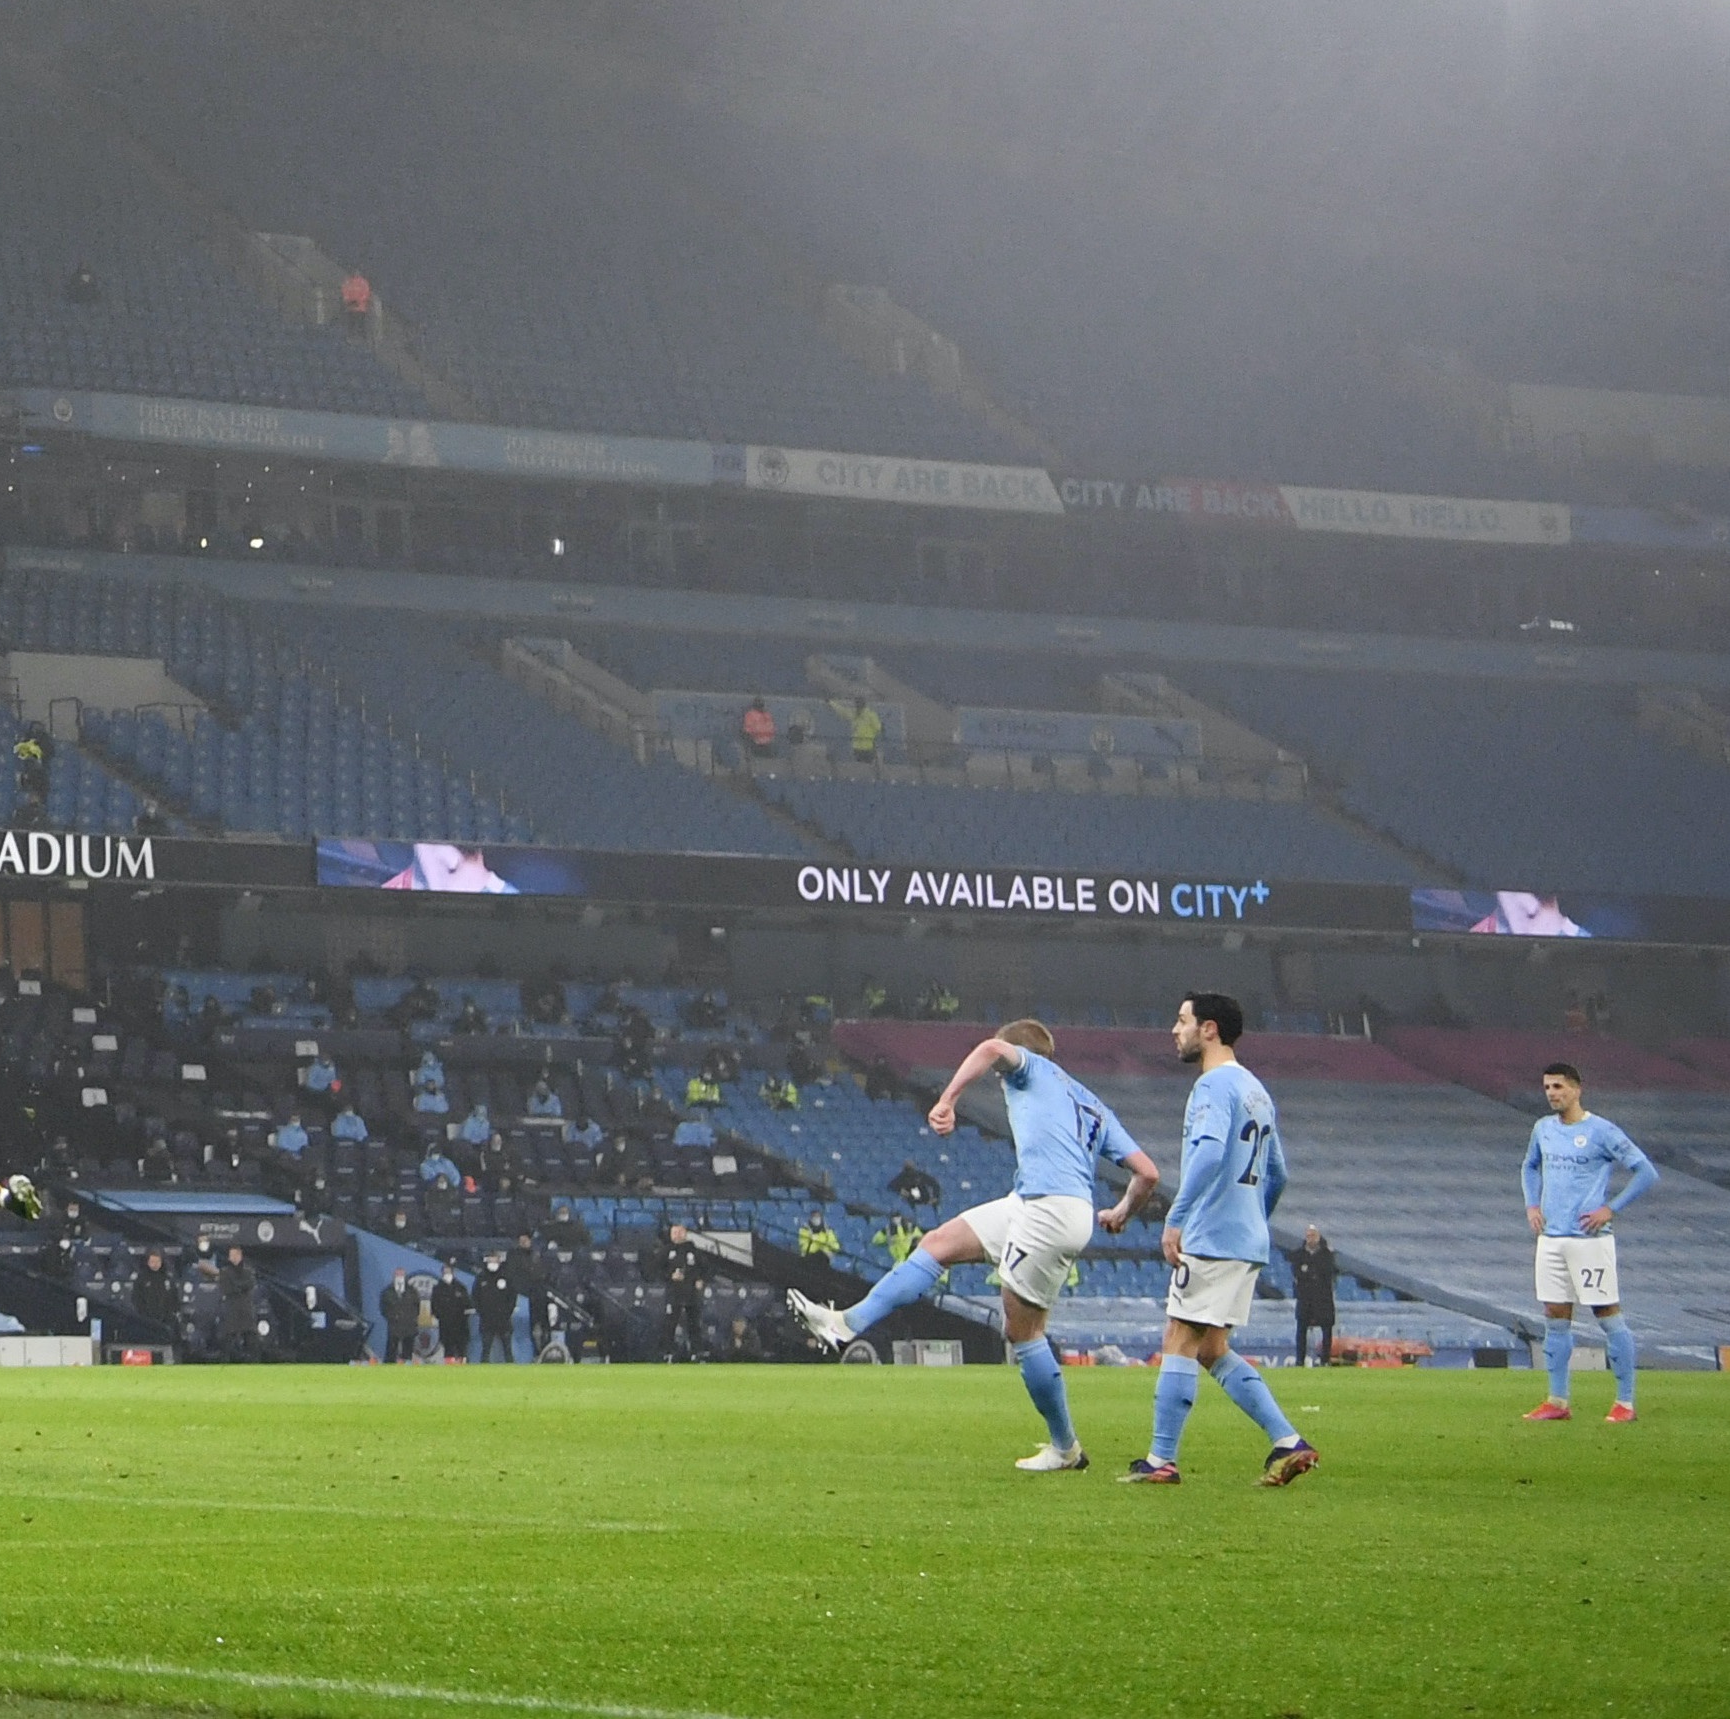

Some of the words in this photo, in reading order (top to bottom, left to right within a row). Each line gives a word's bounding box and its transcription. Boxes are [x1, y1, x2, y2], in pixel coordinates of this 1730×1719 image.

[818, 458, 881, 489] CITY
[895, 465, 950, 494] ARE
[1061, 478, 1125, 509] CITY
[1135, 483, 1191, 513] ARE
[797, 865, 891, 903] ONLY
[904, 870, 1097, 912] AVAILABLE
[1108, 879, 1160, 915] ON
[1170, 880, 1270, 919] CITY+
[1066, 1090, 1103, 1152] 17
[1005, 1241, 1028, 1273] 17
[1580, 1268, 1605, 1289] 27
